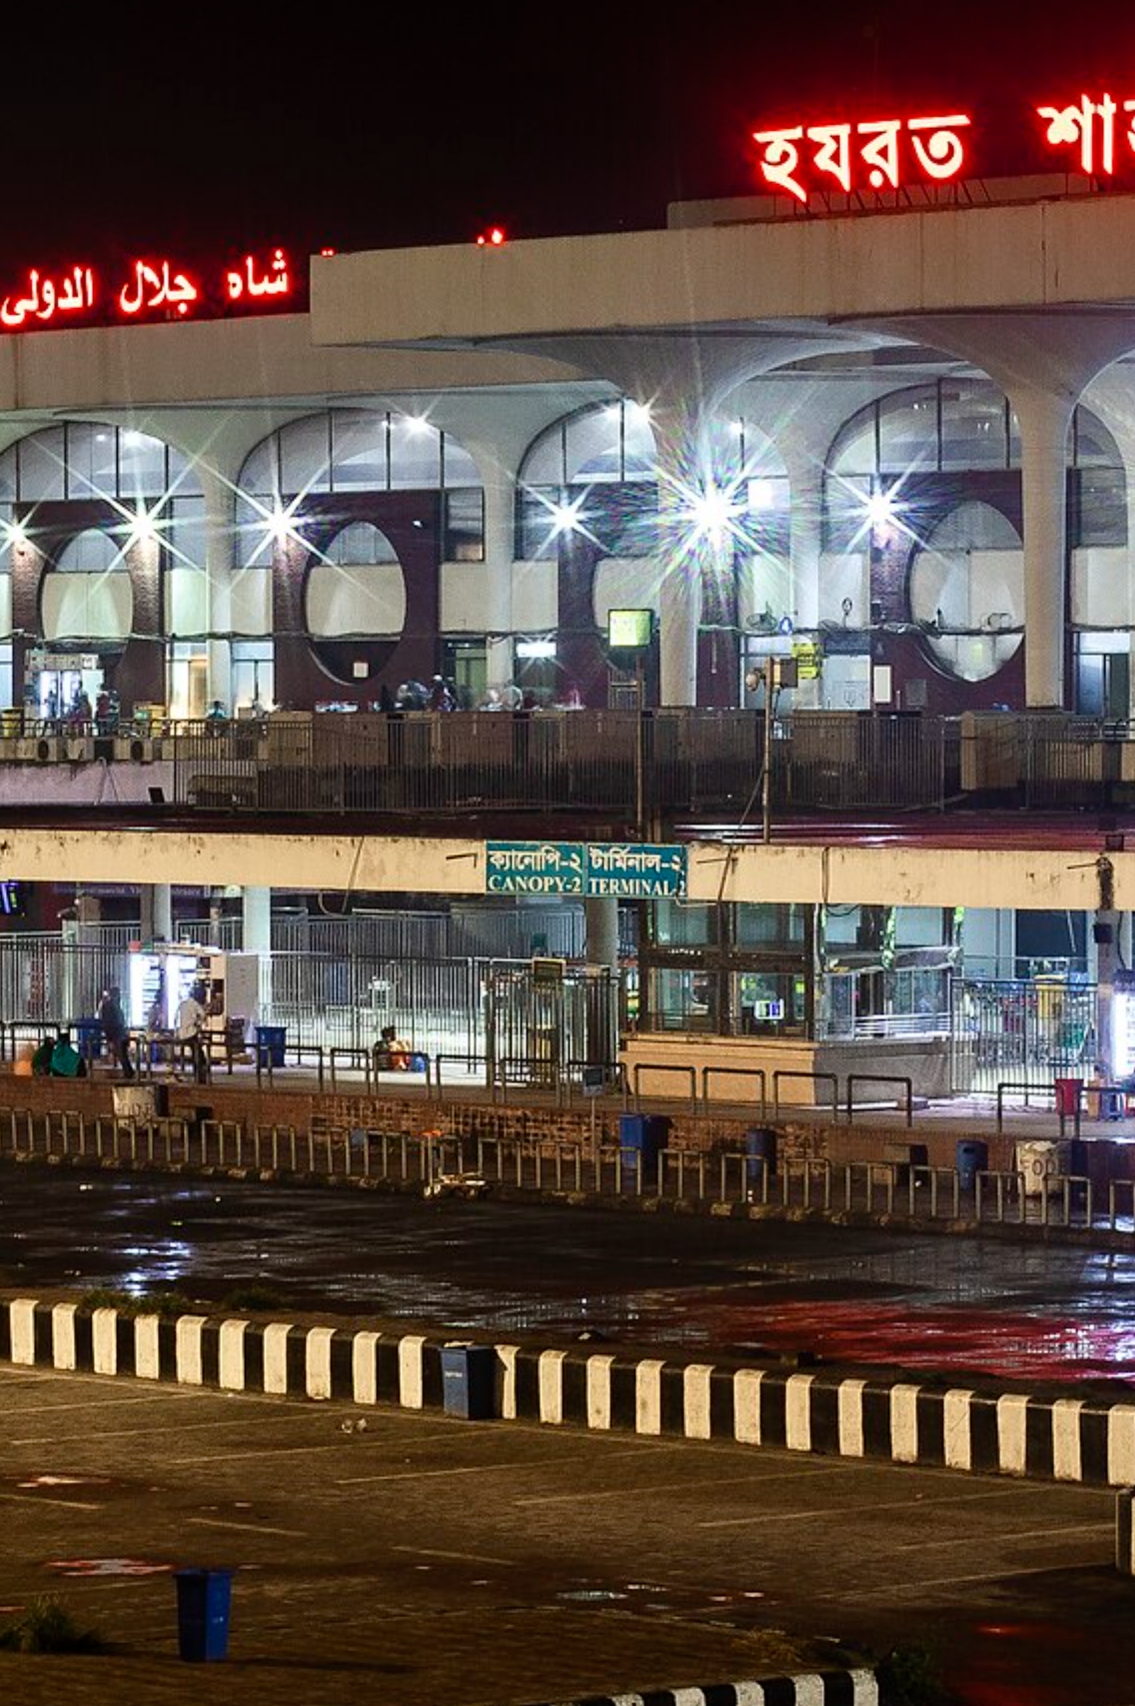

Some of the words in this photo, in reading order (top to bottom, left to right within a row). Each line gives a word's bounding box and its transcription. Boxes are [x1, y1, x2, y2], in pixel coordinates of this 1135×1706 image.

[753, 115, 971, 202] হযরত
[120, 260, 197, 312] جلال
[227, 250, 290, 298] شاه
[488, 846, 582, 873] ক্যানোপি-২
[488, 875, 581, 892] CANOPY-2
[589, 878, 687, 897] TERMINAL-2
